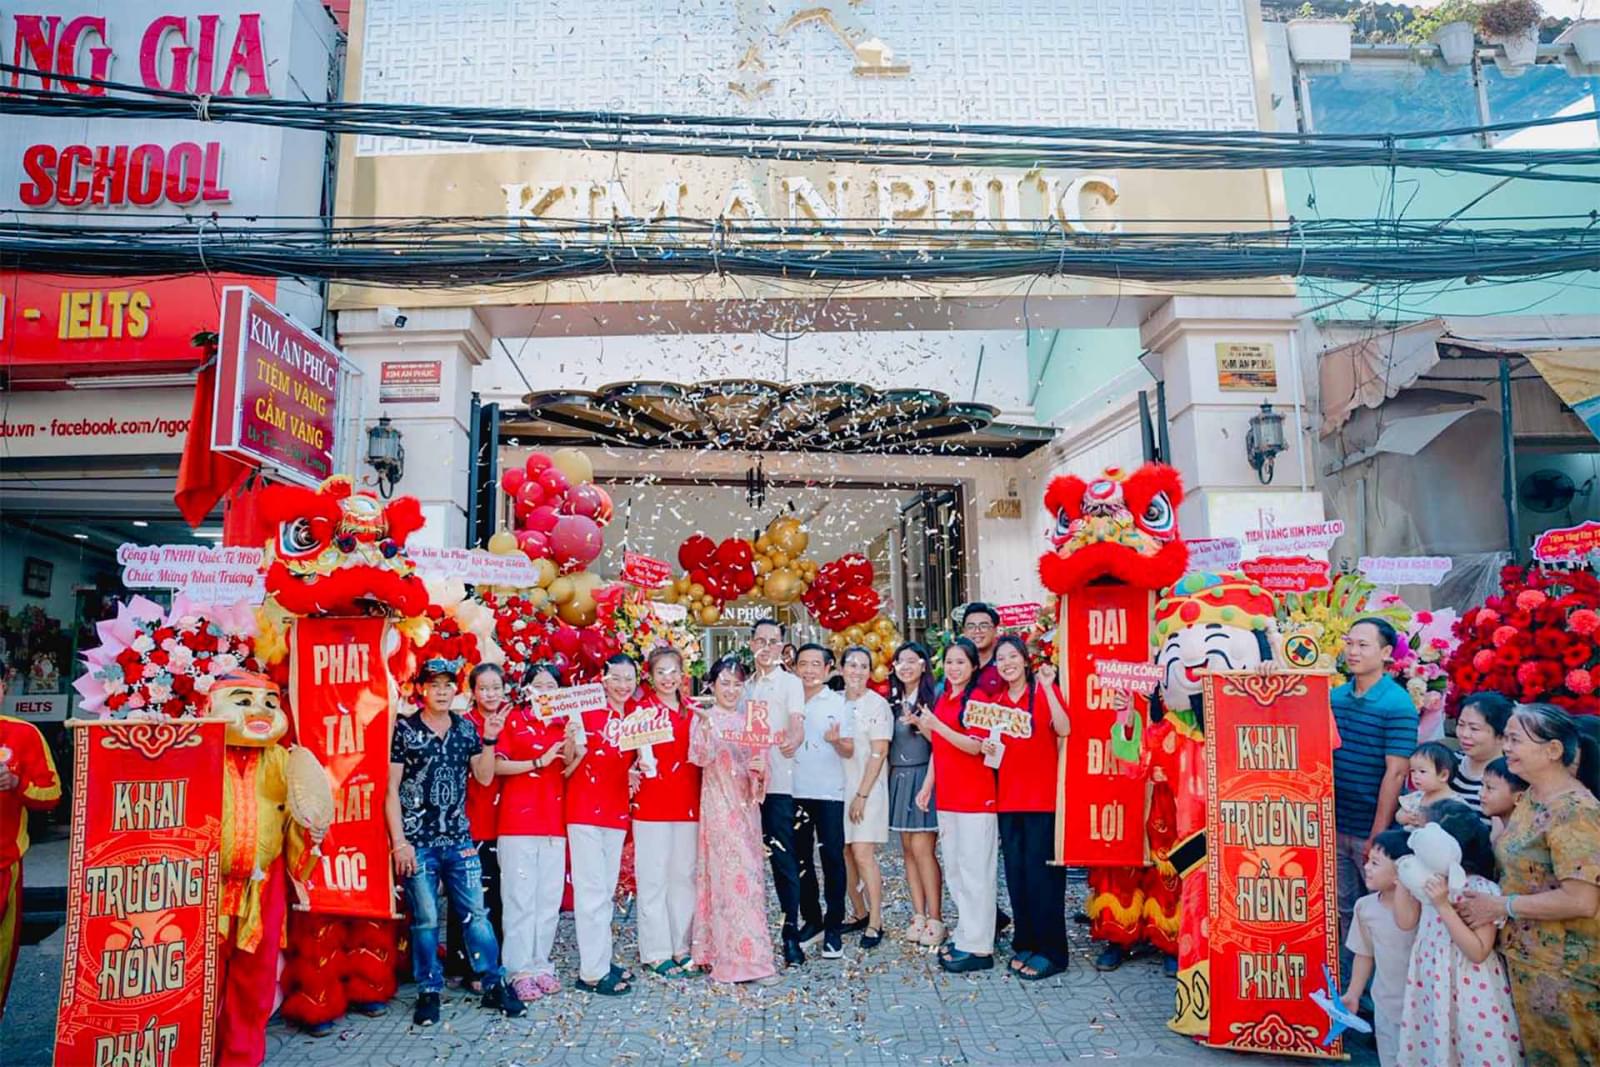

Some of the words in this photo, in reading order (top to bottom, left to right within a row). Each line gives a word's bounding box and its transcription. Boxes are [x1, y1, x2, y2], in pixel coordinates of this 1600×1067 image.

[139, 13, 271, 98] GIA
[19, 142, 232, 208] SCHOOL
[501, 180, 688, 242] KIM
[723, 176, 852, 243] AN
[870, 169, 1121, 243] PHÚC
[58, 291, 151, 339] IELTS
[250, 313, 280, 356] KIM
[281, 337, 302, 370] AN
[302, 350, 335, 391] PHÚC
[255, 391, 287, 432] CẦM
[290, 414, 325, 450] VÀNG
[294, 380, 327, 416] VÀNG
[121, 548, 147, 564] Công
[164, 549, 196, 563] TNHH
[127, 568, 153, 582] Chúc
[1088, 609, 1128, 650] ĐẠI
[313, 637, 370, 686] PHÁT
[15, 701, 53, 713] IELTS
[1236, 725, 1299, 770] KHAI
[112, 779, 188, 832] KHAI
[1089, 799, 1125, 847] LỢI
[1220, 794, 1321, 850] TRƯƠNG
[85, 855, 205, 919] TRƯƠNG
[1237, 858, 1308, 923] HỒNG
[97, 927, 186, 1001] HỒNG
[1239, 943, 1307, 1000] PHÁT
[95, 1016, 179, 1067] PHÁT
